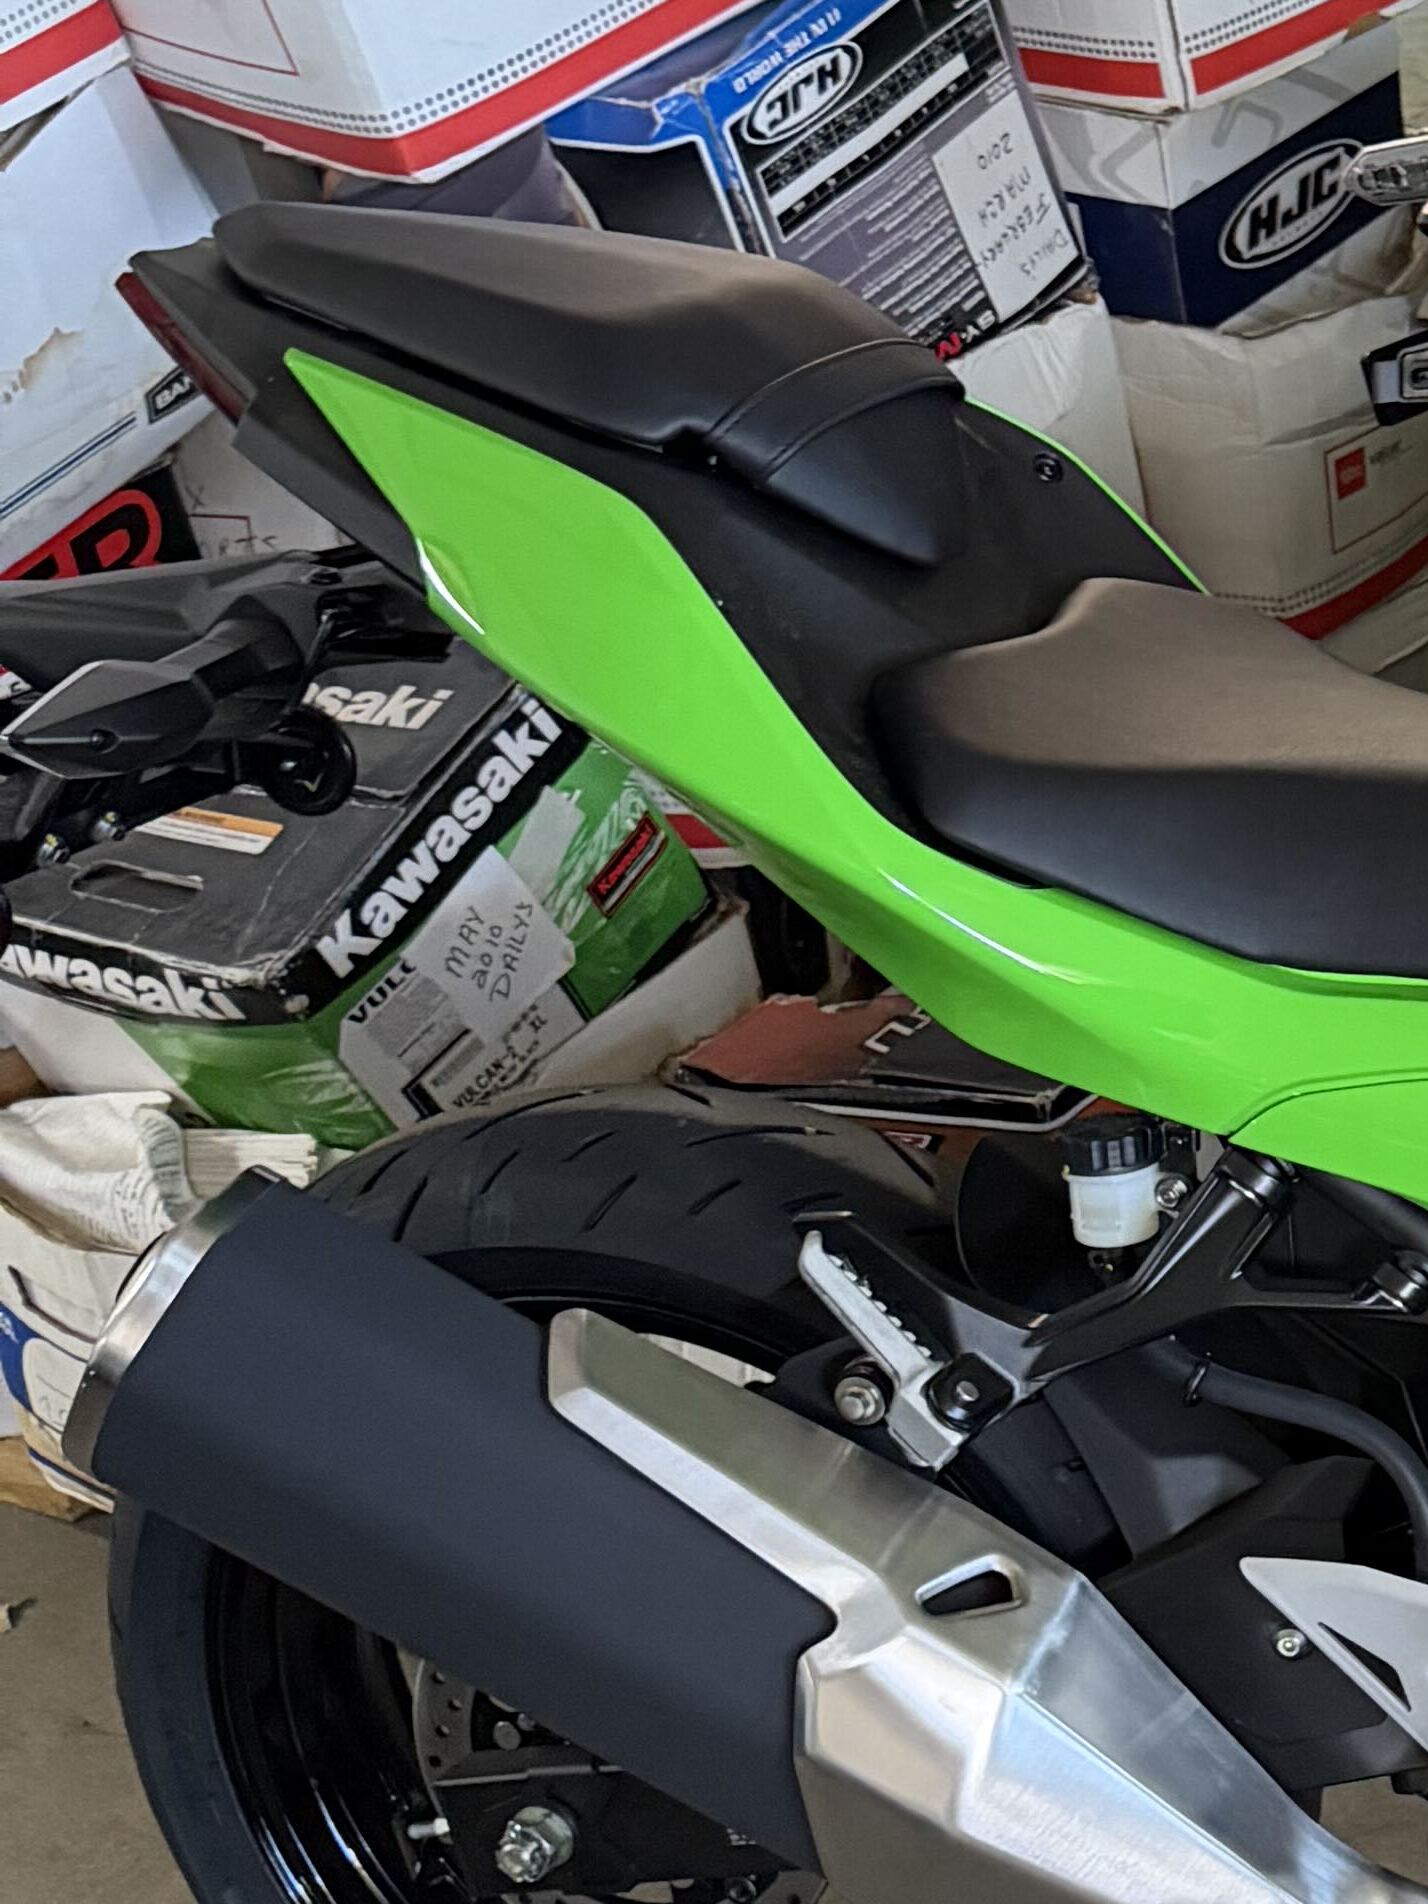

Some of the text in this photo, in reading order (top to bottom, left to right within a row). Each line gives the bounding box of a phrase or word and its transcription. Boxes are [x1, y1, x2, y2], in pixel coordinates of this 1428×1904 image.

[731, 50, 785, 95] WORLD
[765, 54, 842, 134] HJC
[1247, 153, 1343, 253] HJC
[315, 696, 564, 980] Kawasaki
[445, 905, 486, 979] MAY
